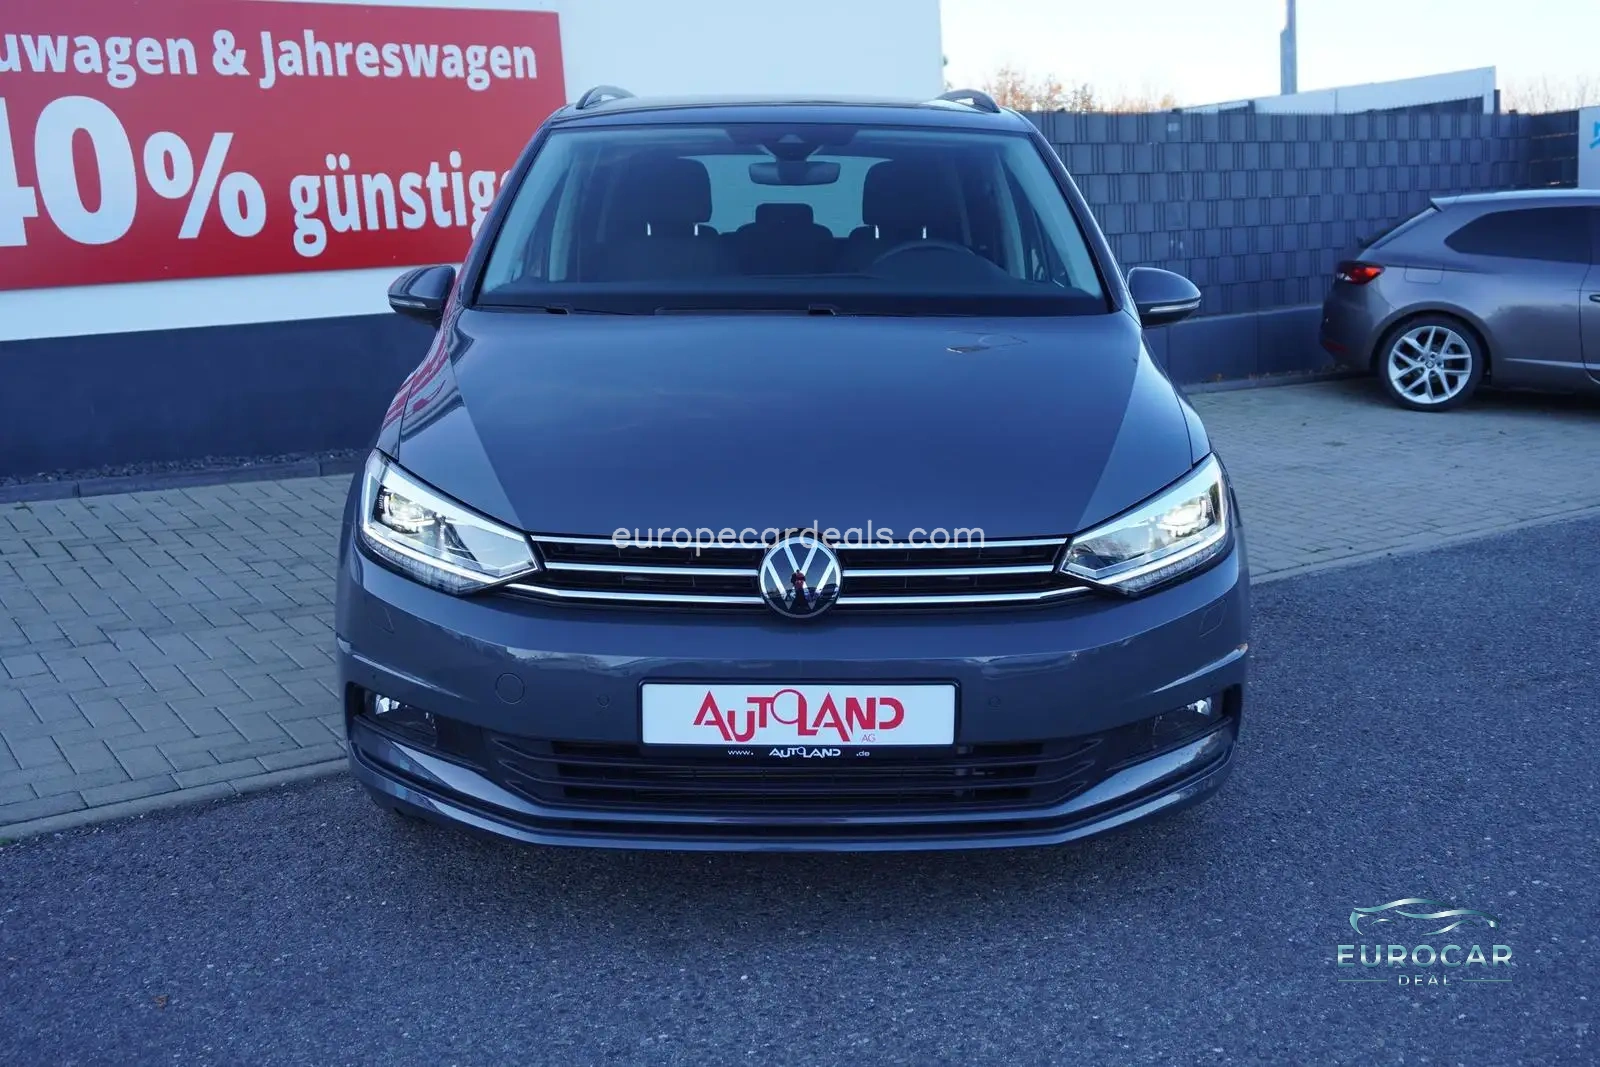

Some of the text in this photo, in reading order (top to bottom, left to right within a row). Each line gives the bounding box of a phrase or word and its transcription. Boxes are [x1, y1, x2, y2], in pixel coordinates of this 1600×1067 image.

[212, 29, 250, 76] &
[259, 30, 537, 91] Jahreswagen
[289, 151, 511, 258] günstig
[861, 733, 876, 743] AG
